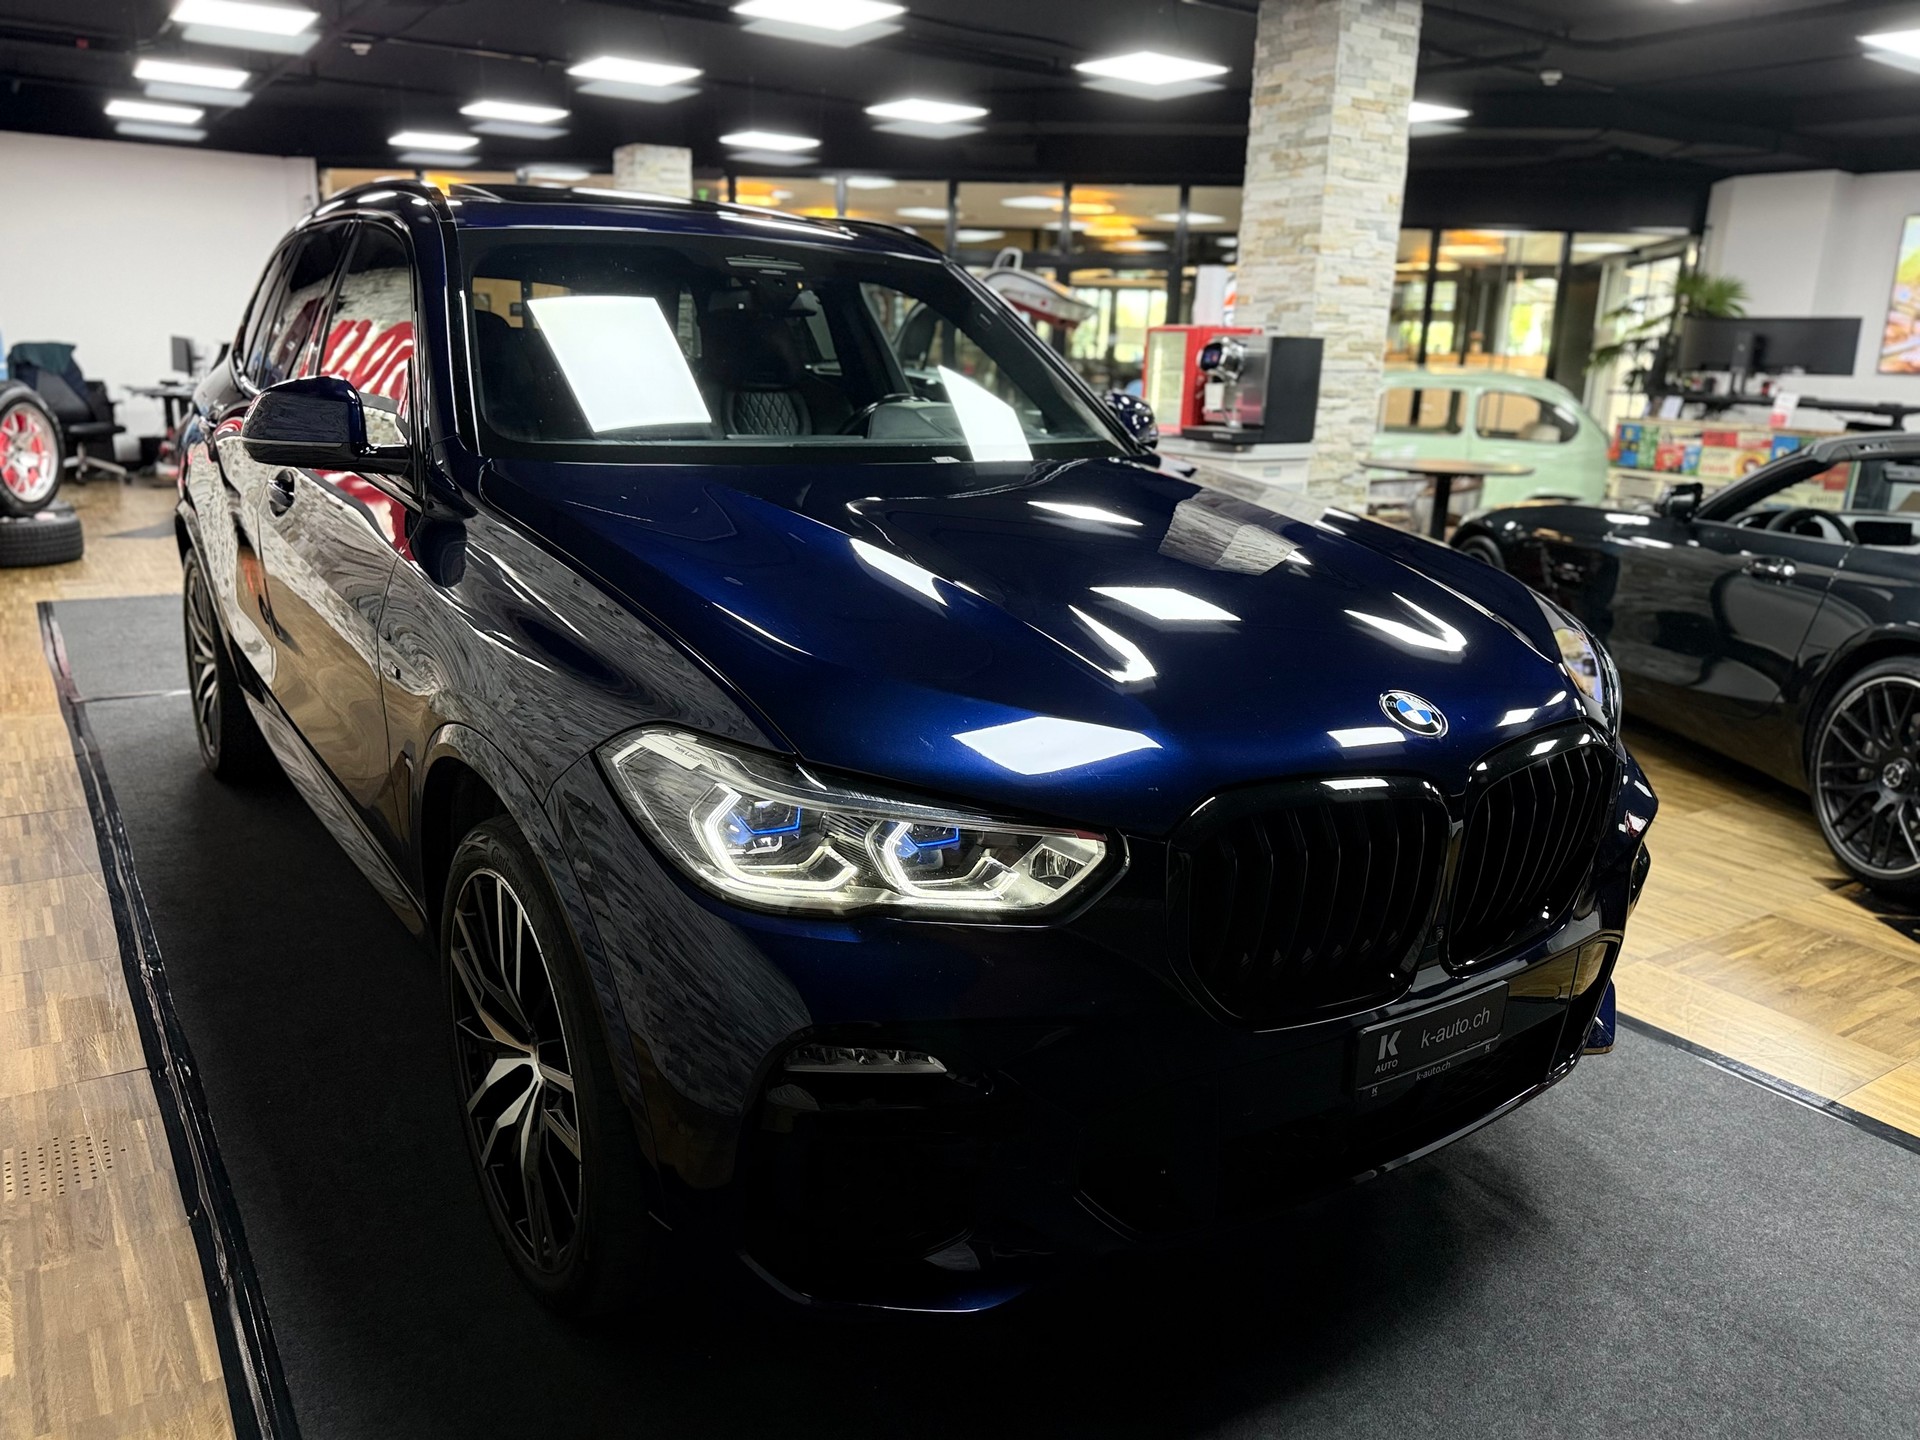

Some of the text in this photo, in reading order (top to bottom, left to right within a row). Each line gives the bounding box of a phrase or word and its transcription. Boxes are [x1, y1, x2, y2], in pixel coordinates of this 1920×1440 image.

[1420, 1006, 1491, 1049] k-auto.ch
[1377, 1029, 1402, 1061] K
[1374, 1059, 1399, 1075] AUTO
[1415, 1060, 1451, 1082] k-auto.ch
